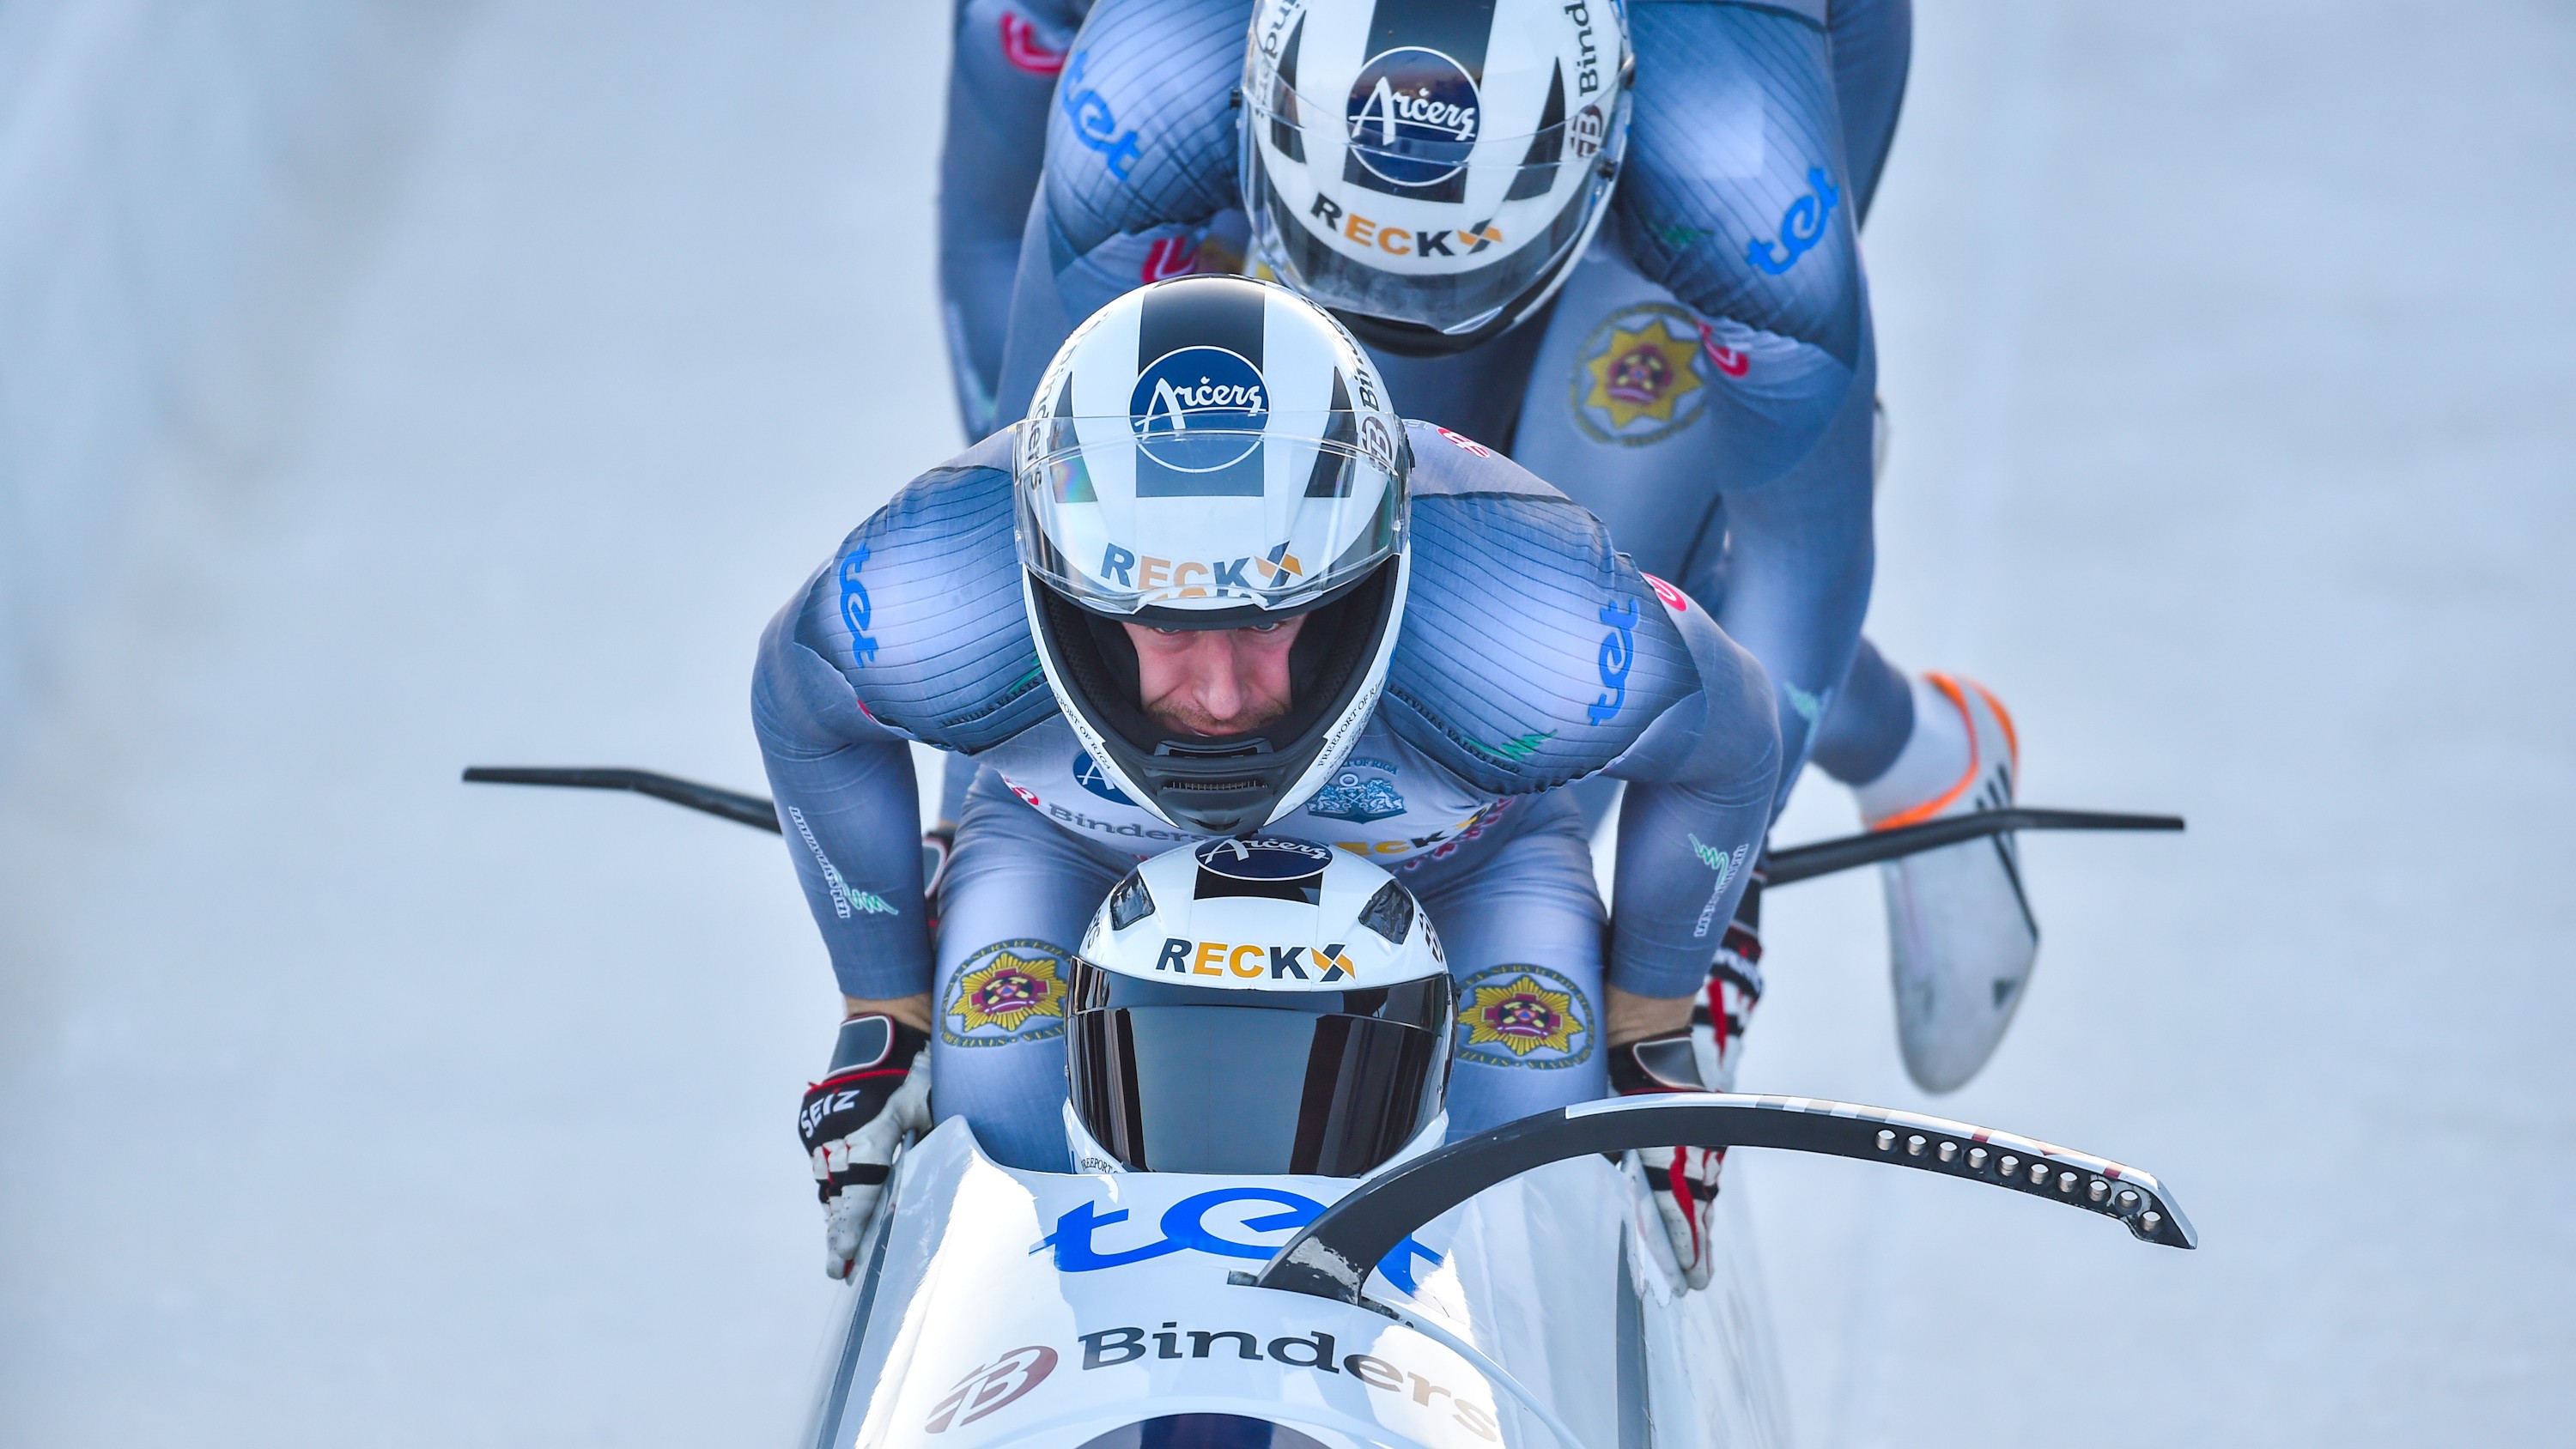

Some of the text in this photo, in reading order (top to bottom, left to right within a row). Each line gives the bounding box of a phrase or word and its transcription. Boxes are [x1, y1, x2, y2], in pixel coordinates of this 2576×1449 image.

[1062, 50, 1141, 180] tet
[1745, 167, 1838, 275] tet
[839, 542, 875, 668] tet
[1588, 598, 1639, 726] tet
[1079, 724, 1092, 741] OF
[1091, 743, 1111, 771] RIGA
[1318, 708, 1358, 768] FREEPORT
[1358, 694, 1369, 711] OF
[1373, 760, 1398, 775] RIGA
[800, 1088, 860, 1138] SEIZ
[1077, 1322, 1498, 1443] Binders
